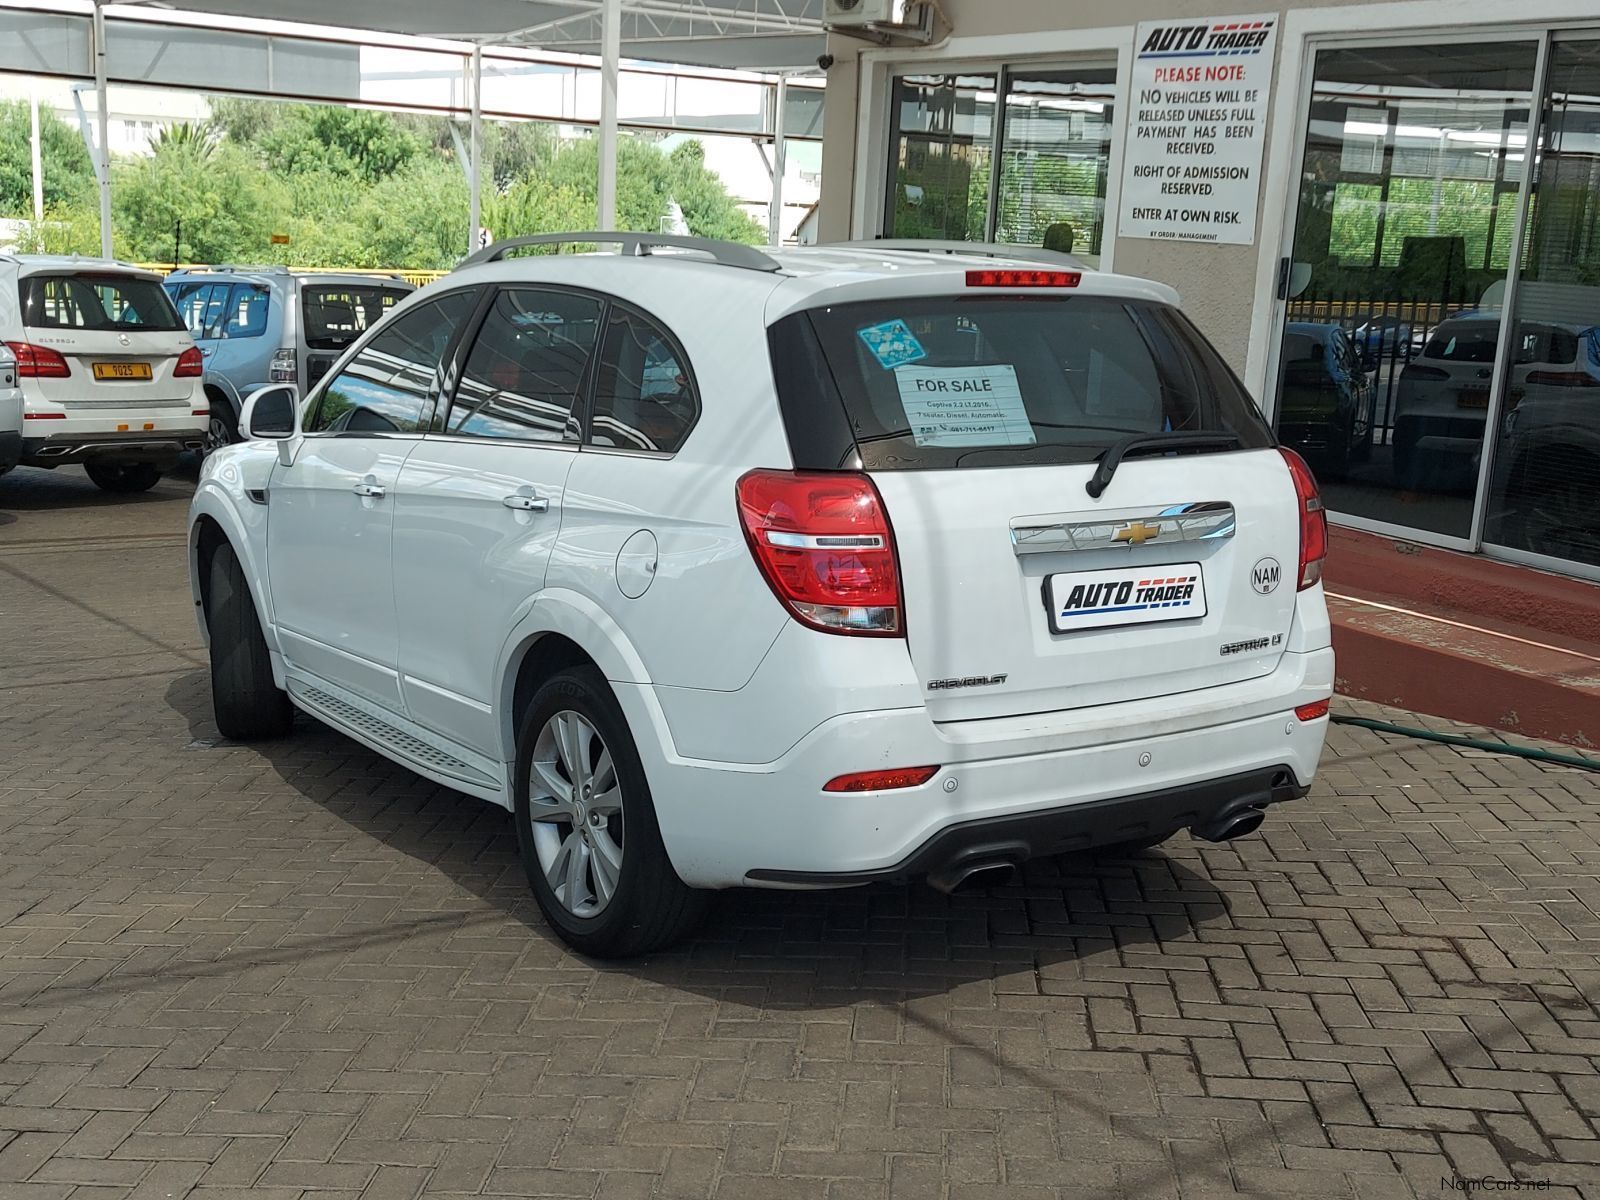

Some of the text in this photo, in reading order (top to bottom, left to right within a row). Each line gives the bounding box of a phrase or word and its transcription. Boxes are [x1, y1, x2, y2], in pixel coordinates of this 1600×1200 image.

[1141, 26, 1269, 52] AUTO TRADER
[1154, 65, 1246, 83] PLEASE NOTE:
[1140, 89, 1258, 104] NO VEHICLES WILL BE
[1138, 108, 1255, 122] RELEASED UNLESS FULL
[1137, 125, 1253, 138] PAYMENT HAS BEEN
[1166, 142, 1216, 155] RECEIVED.
[1133, 165, 1249, 179] RIGHT OF ADMISSION
[1161, 182, 1214, 196] RESERVED.
[1132, 207, 1241, 224] ENTER AT OWN RISK.
[1178, 232, 1218, 240] MANAGEMENT
[112, 364, 133, 376] 9025
[916, 379, 992, 393] FOR SALE
[926, 400, 952, 410] Captiva
[1254, 566, 1279, 585] NAM
[1063, 581, 1195, 610] AUTO TRADER
[1220, 633, 1284, 656] CAPTIVA LT
[927, 673, 1008, 691] CHEVROLET
